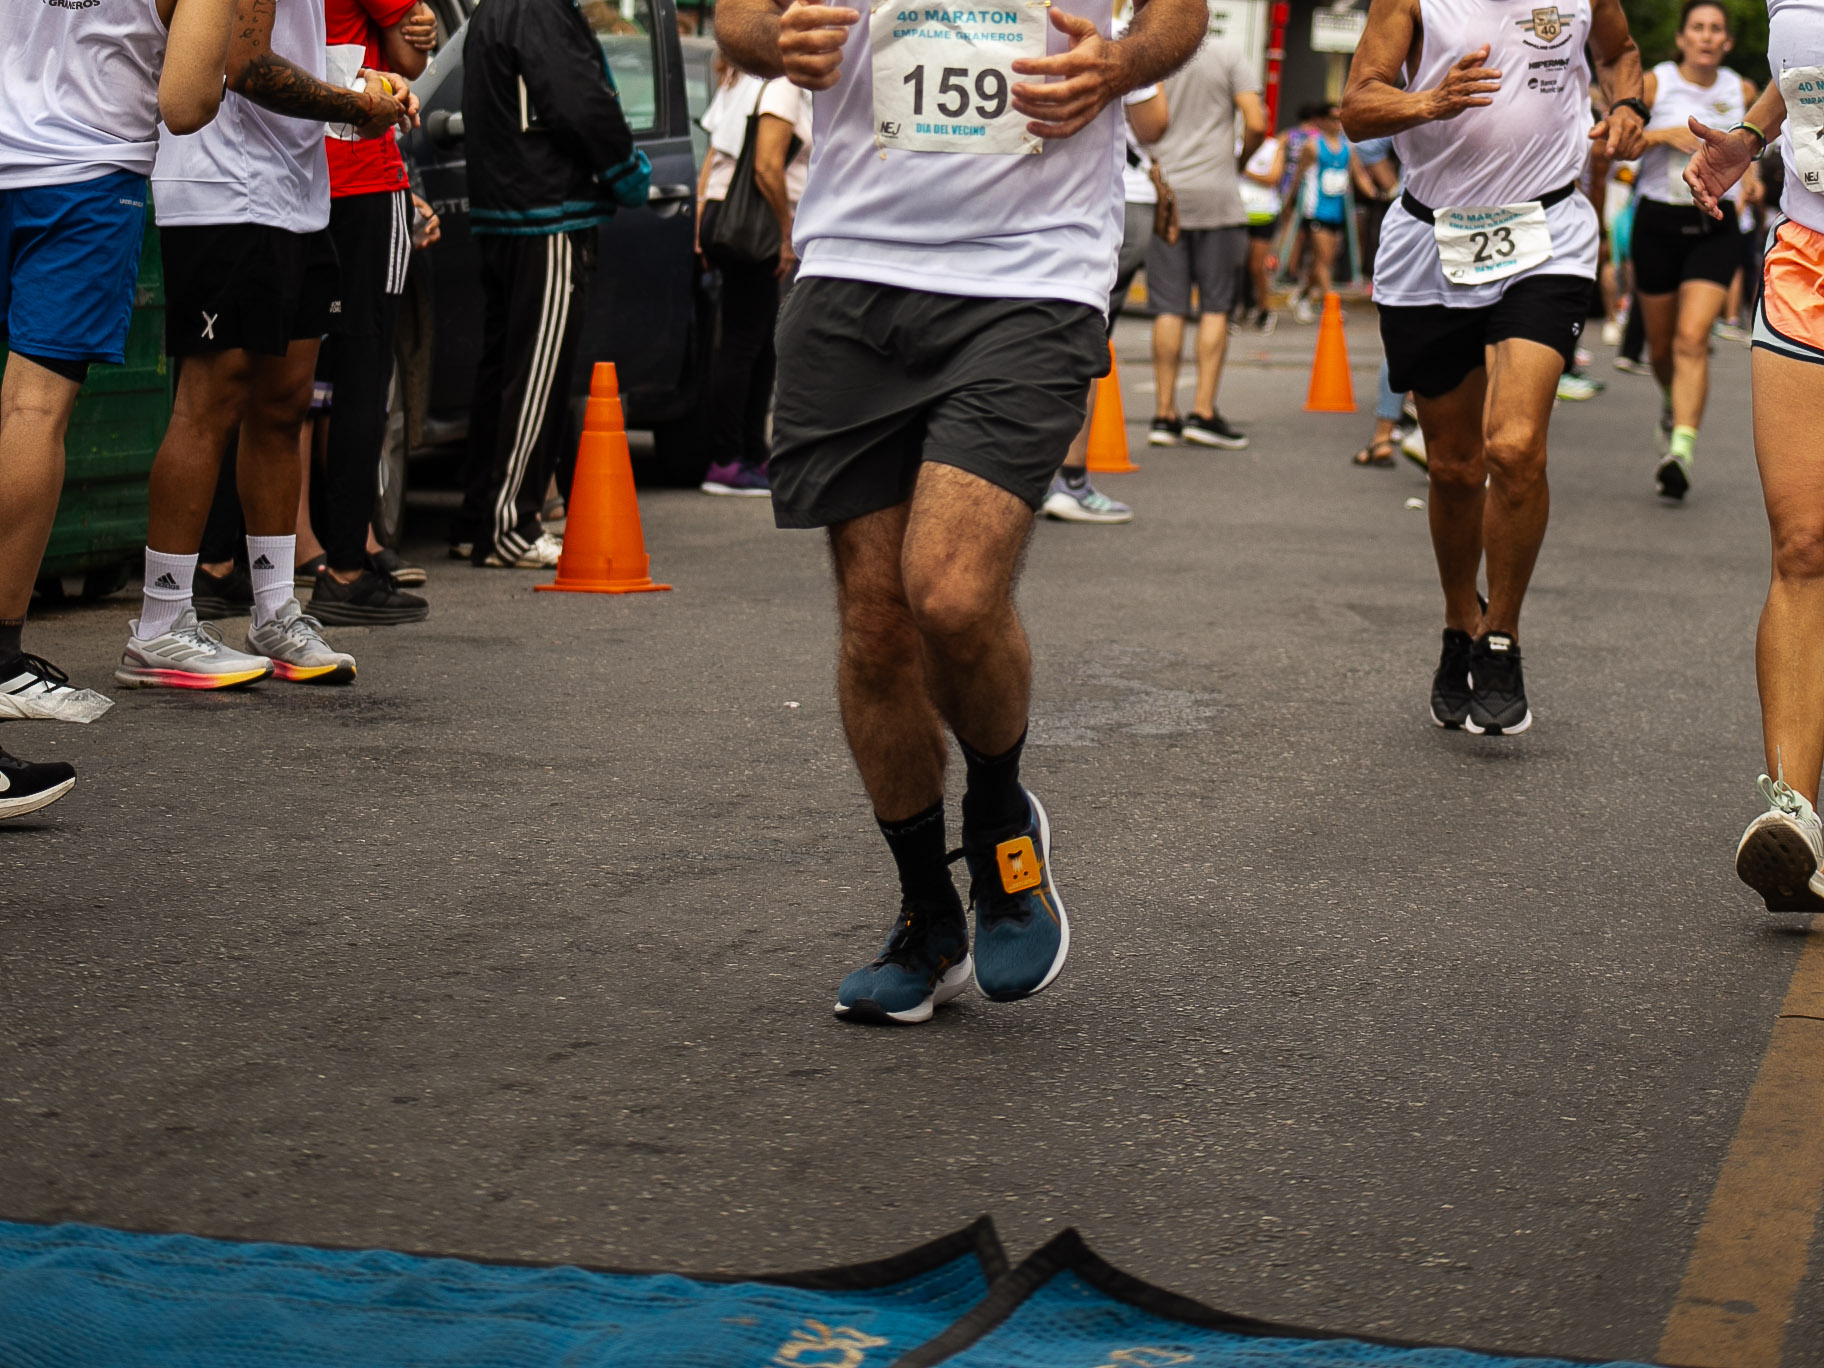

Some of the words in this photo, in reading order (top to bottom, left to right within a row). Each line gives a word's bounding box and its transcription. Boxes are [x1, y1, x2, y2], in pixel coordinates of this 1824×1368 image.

[897, 11, 918, 22] 40
[924, 10, 1018, 25] MARATON
[892, 28, 952, 40] EMPALME
[955, 31, 1024, 43] GRANEROS
[1541, 24, 1557, 35] 40
[903, 64, 1008, 120] 159
[1798, 81, 1814, 92] 40
[916, 122, 931, 134] DIA
[933, 123, 950, 135] DEL
[952, 125, 986, 137] VECINO
[1469, 226, 1516, 264] 23
